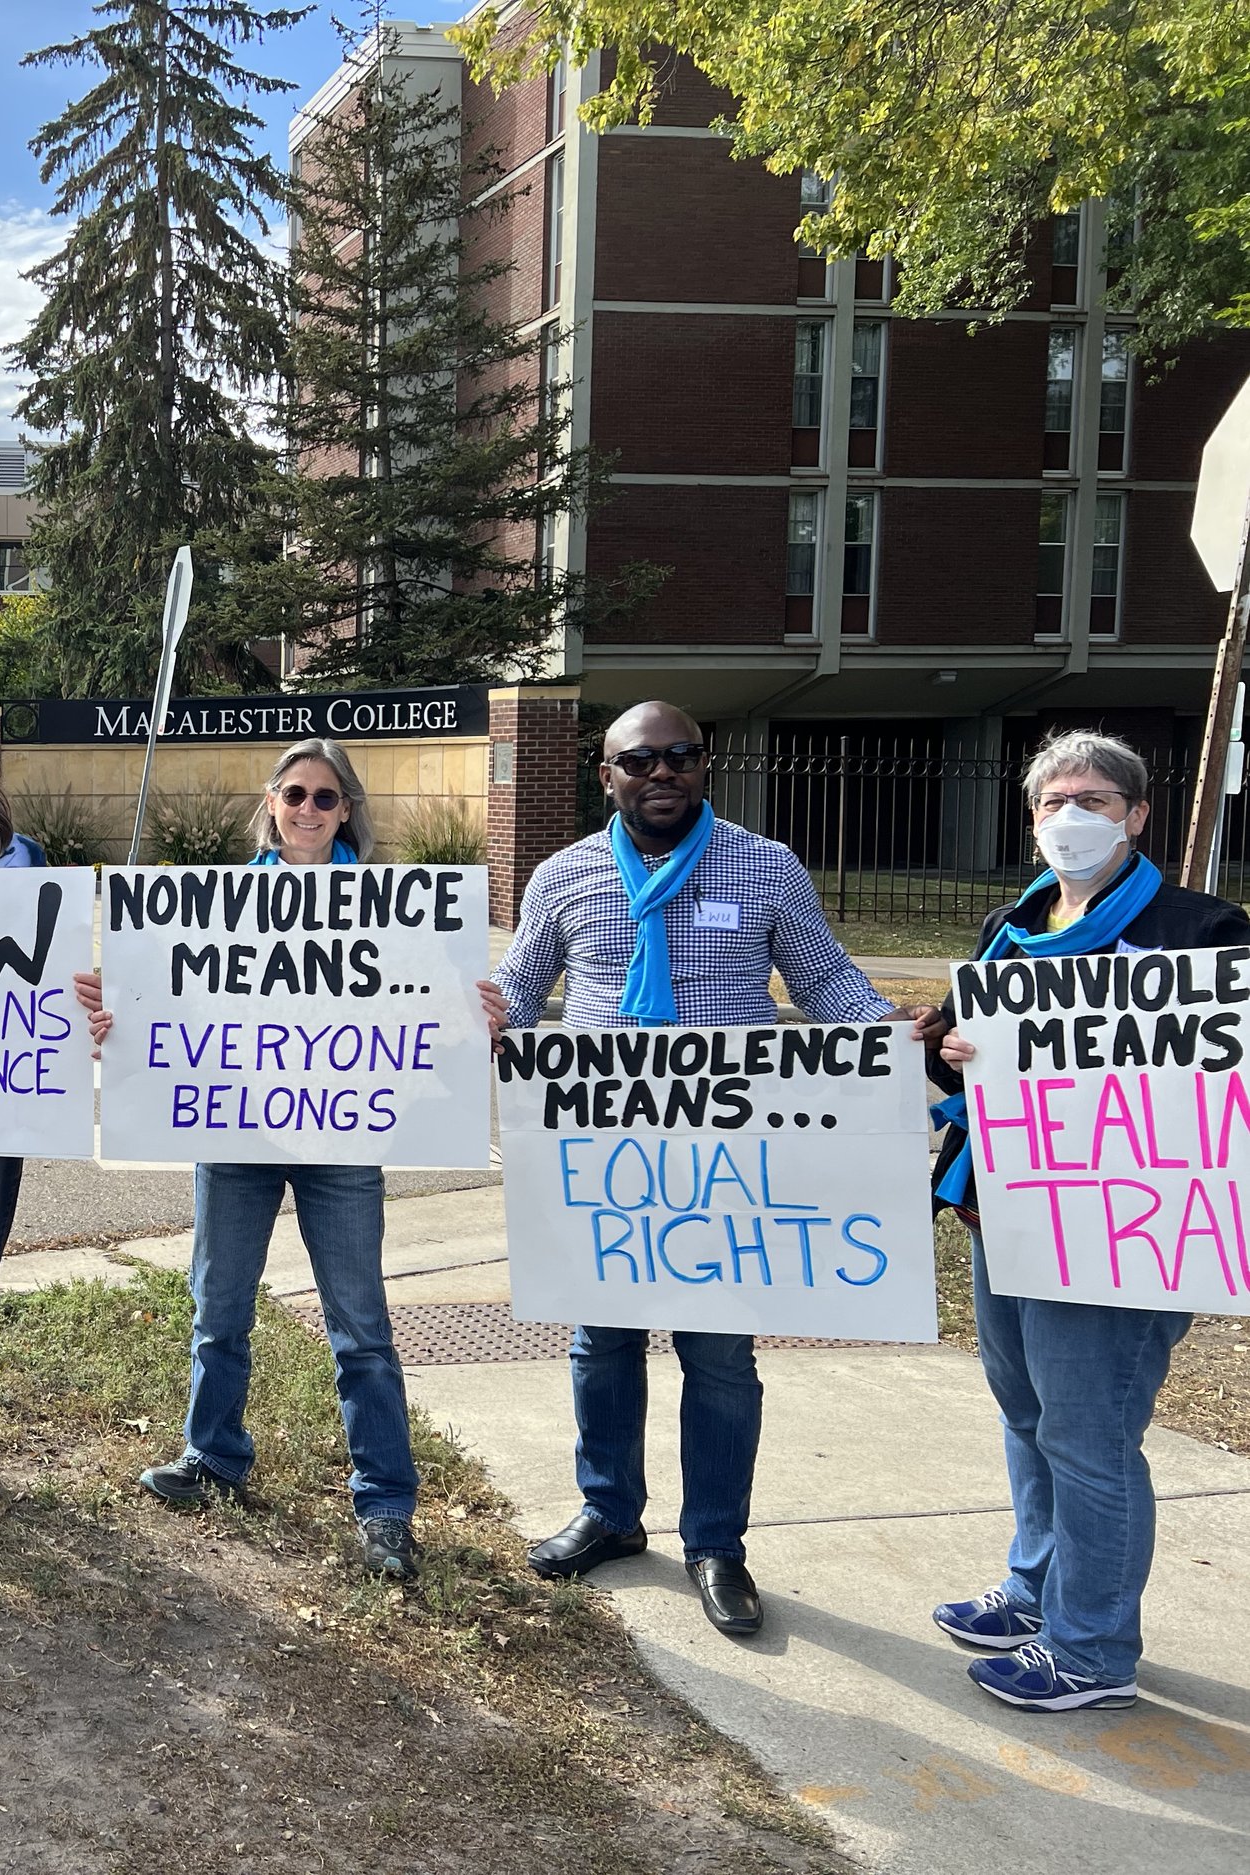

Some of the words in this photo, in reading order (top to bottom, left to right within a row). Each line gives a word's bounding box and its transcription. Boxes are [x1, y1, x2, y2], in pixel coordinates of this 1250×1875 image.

[327, 699, 458, 732] COLLEGE
[110, 868, 462, 933] NONVIOLENCE
[172, 939, 429, 997] MEANS...
[958, 948, 1250, 1019] NONVIOLE
[149, 1023, 437, 1071] EVERYONE
[497, 1027, 892, 1084] NONVIOLENCE
[1019, 1013, 1242, 1072] MEANS
[173, 1085, 395, 1132] BELONGS
[559, 1137, 818, 1212] EQUAL
[588, 1206, 888, 1288] RIGHTS
